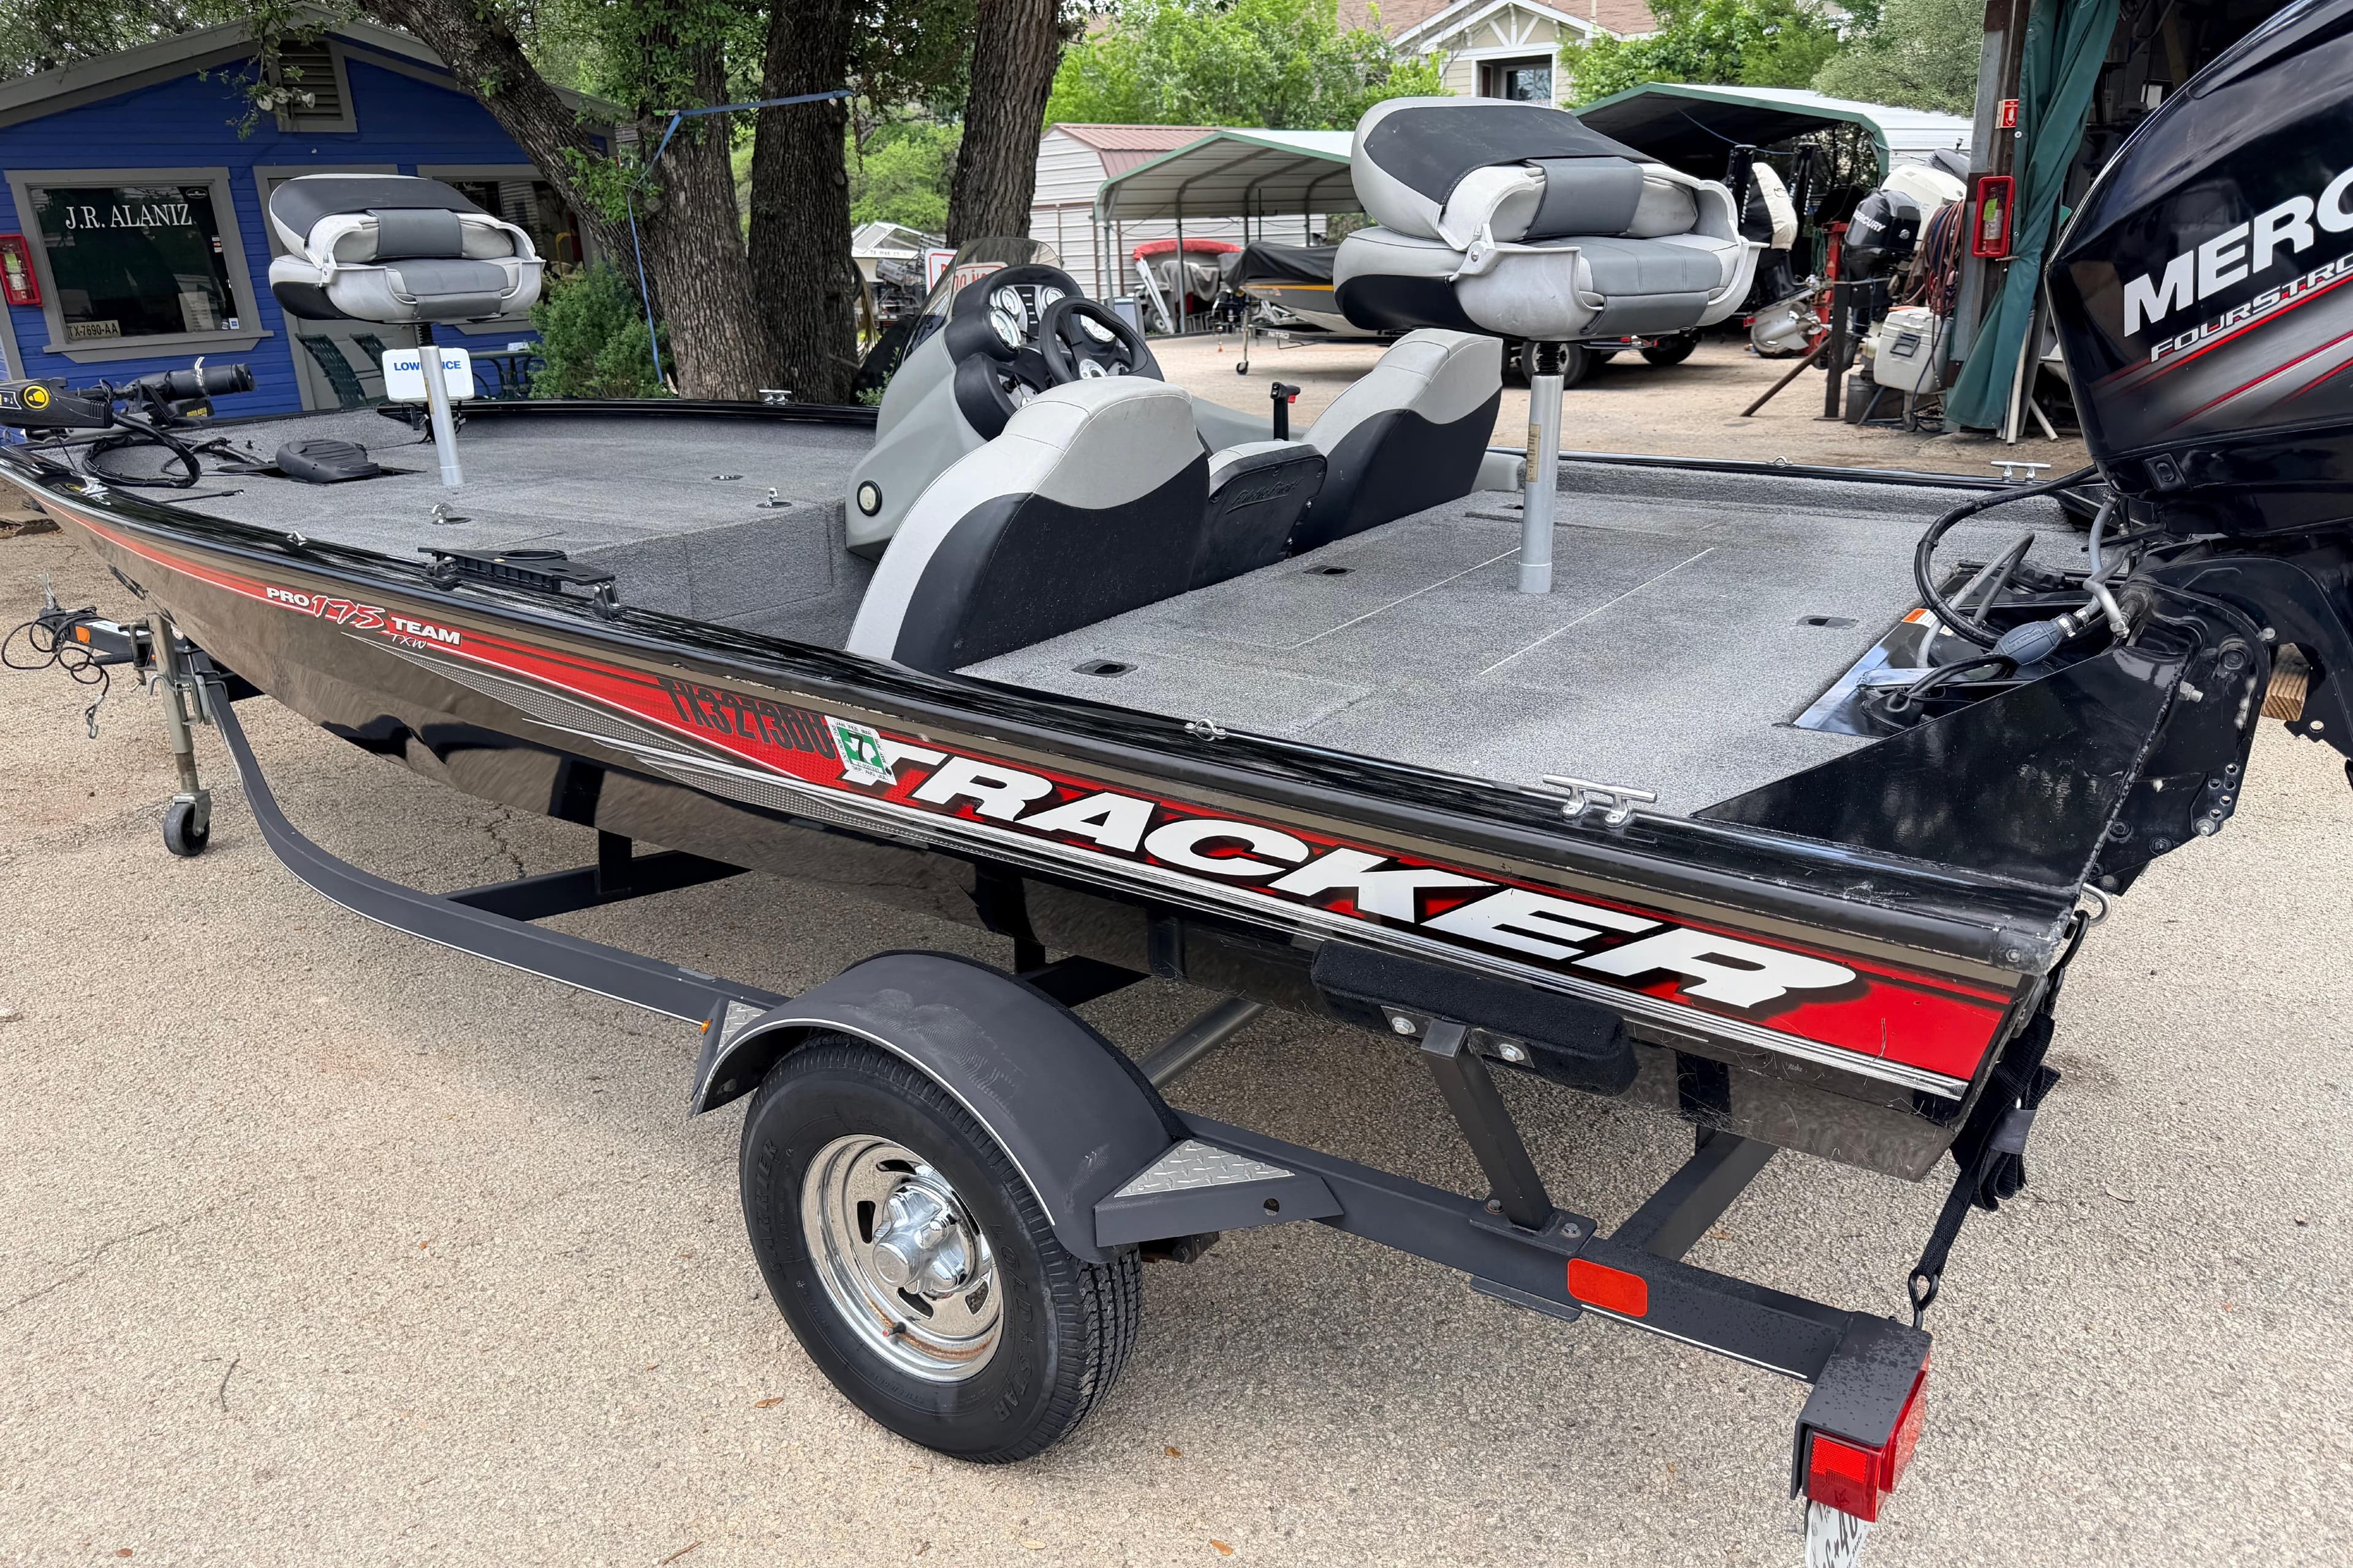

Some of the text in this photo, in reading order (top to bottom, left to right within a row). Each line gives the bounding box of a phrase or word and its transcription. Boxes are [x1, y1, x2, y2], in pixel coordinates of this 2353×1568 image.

[65, 203, 192, 230] J.R. ALANIZ
[266, 586, 461, 645] PRO 175 TEAM
[389, 632, 428, 650] TXW
[841, 737, 1857, 1007] TRACKER
